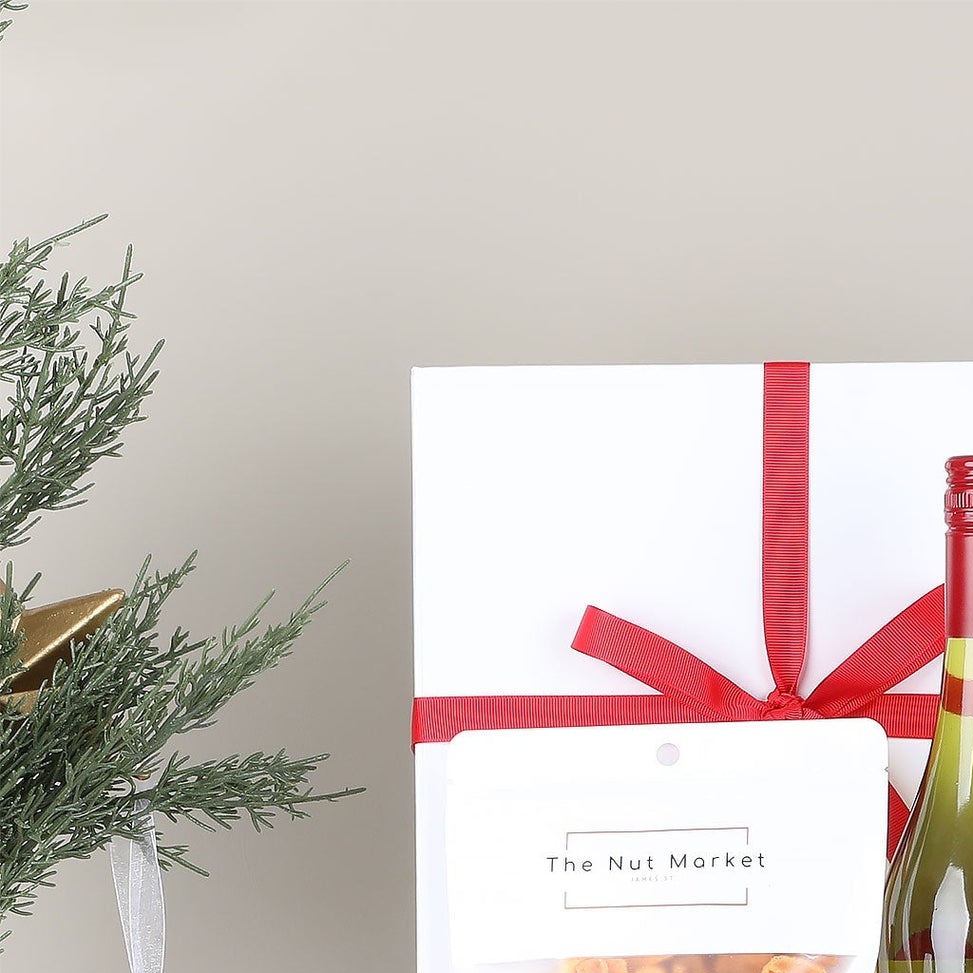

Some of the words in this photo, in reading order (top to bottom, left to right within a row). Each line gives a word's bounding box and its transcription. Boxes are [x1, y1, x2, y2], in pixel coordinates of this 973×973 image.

[546, 856, 593, 872] The
[609, 855, 654, 871] Nut
[669, 852, 765, 868] Market
